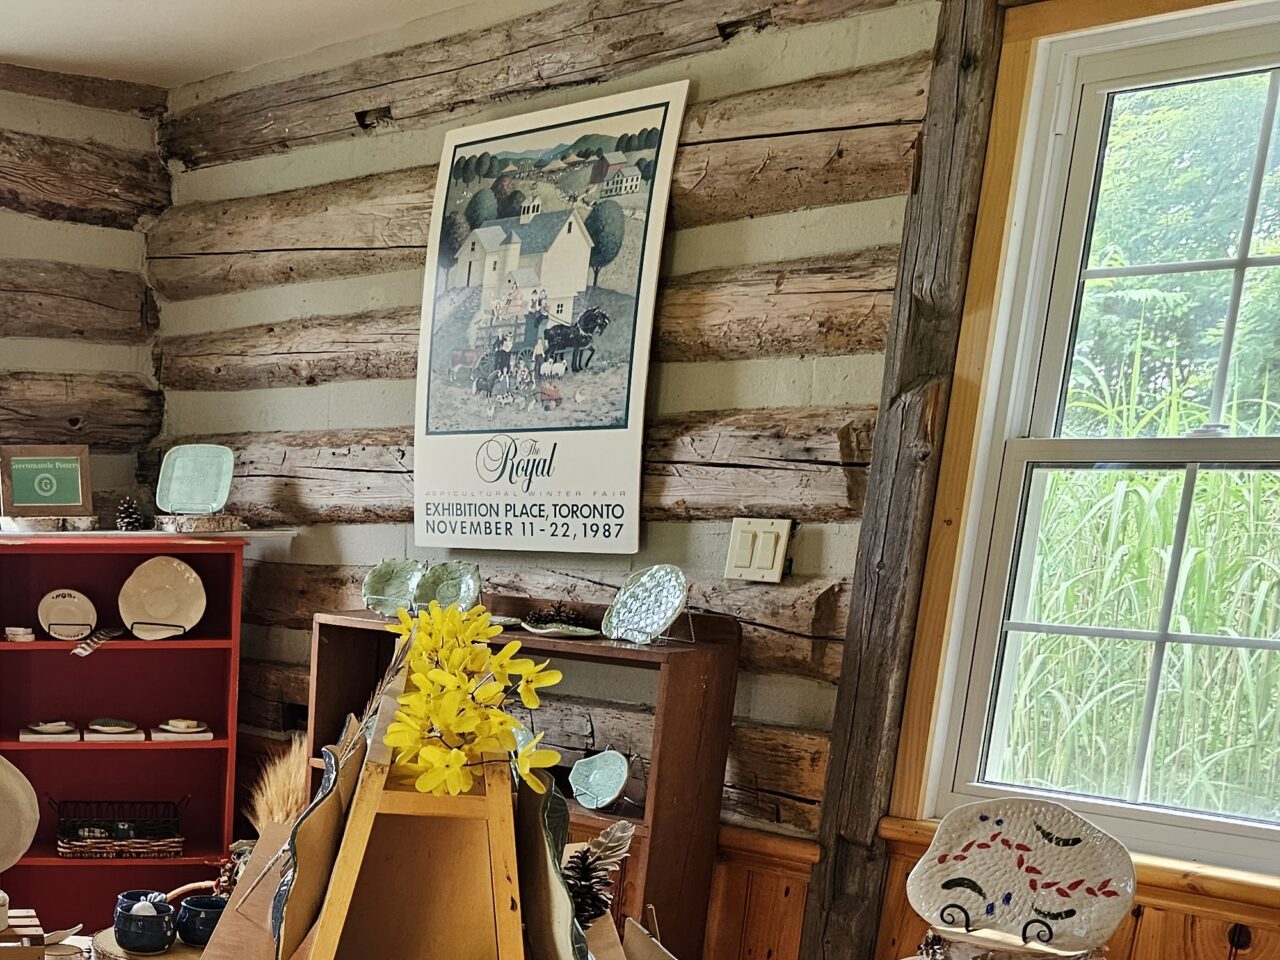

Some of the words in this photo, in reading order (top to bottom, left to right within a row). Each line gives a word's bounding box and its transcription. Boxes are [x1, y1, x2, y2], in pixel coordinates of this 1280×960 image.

[520, 438, 541, 457] The
[476, 434, 558, 493] Royal
[425, 502, 500, 518] EXHIBITION
[504, 503, 549, 521] PLACE,
[552, 503, 625, 519] TORONTO
[426, 520, 513, 536] NOVEMBER
[582, 523, 624, 538] 1987
